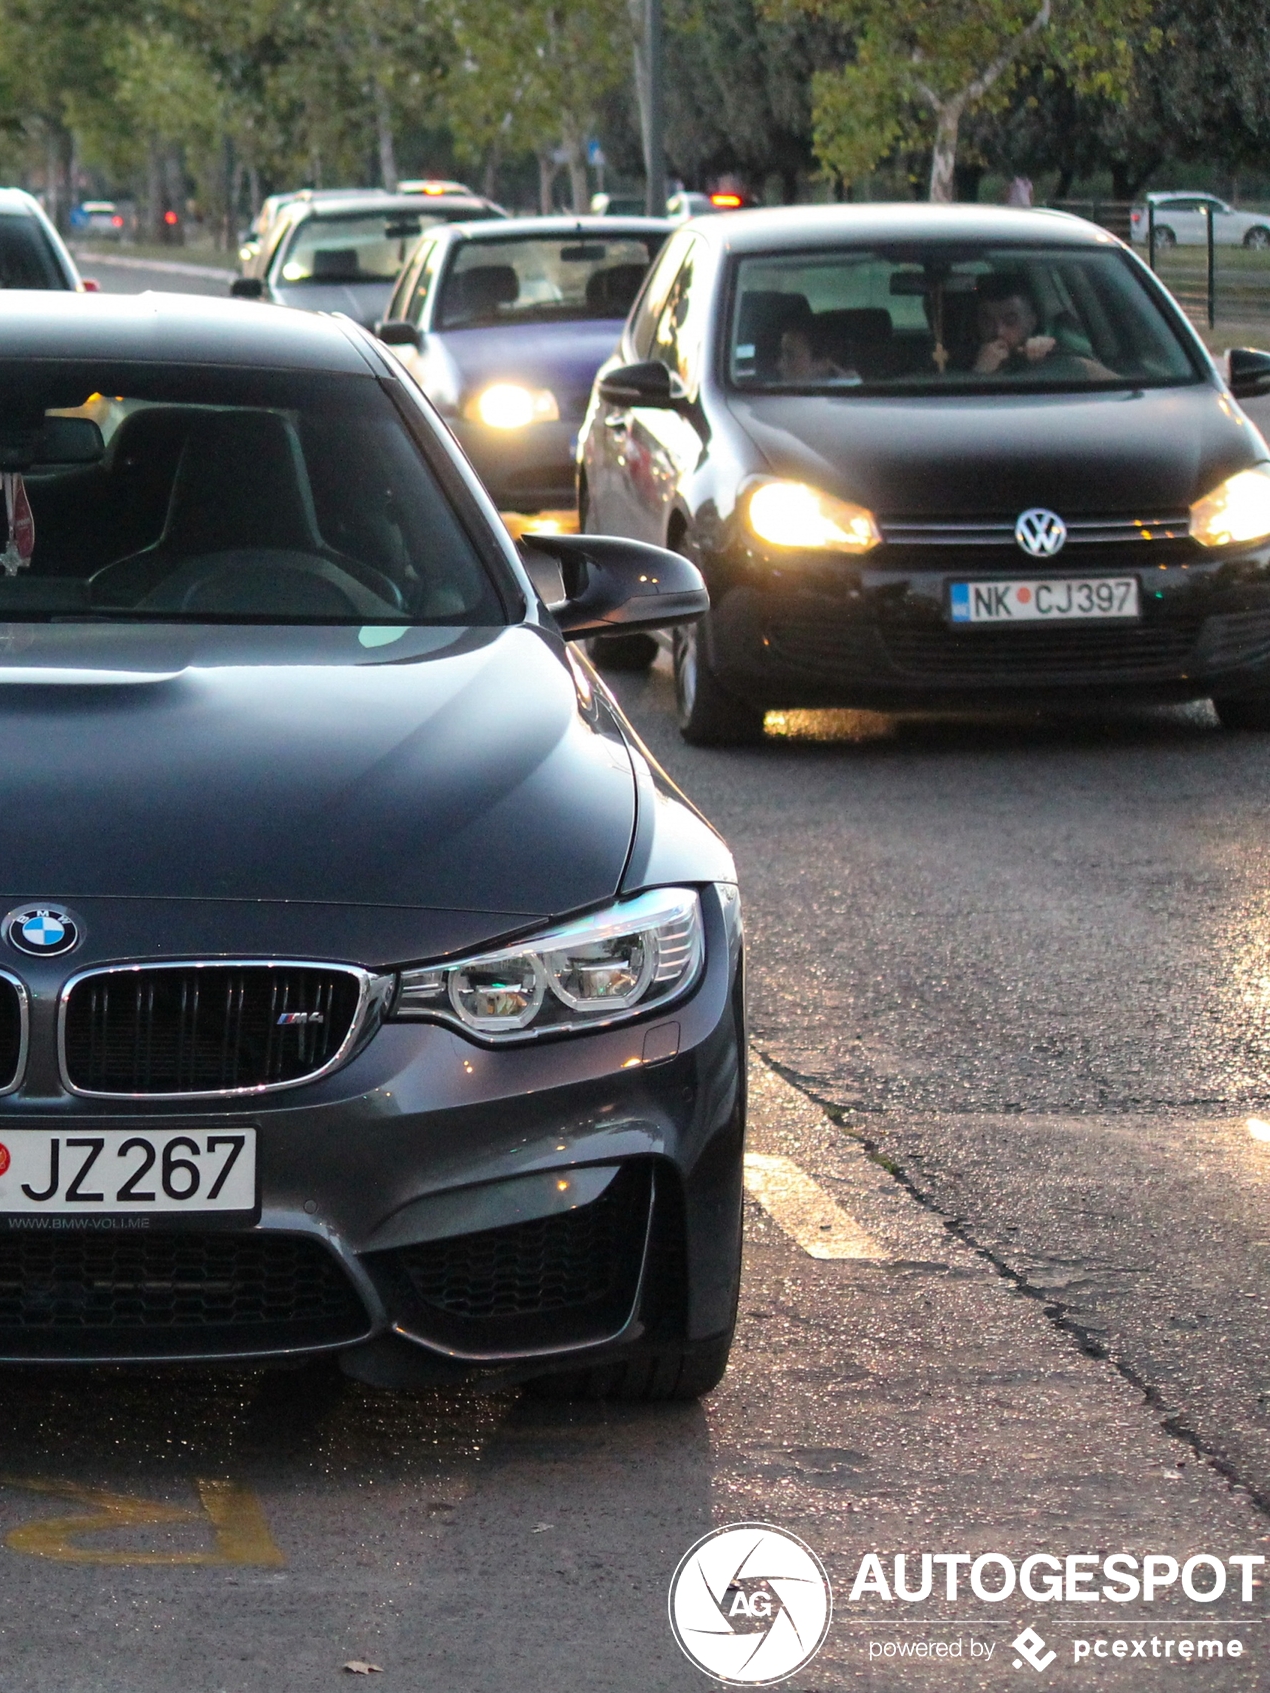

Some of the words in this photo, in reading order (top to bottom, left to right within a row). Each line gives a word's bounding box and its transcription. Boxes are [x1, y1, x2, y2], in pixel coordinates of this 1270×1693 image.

[1015, 508, 1067, 557] VW
[974, 586, 1011, 616] NK
[1034, 582, 1132, 615] CJ397
[16, 910, 72, 925] BMW
[289, 1011, 324, 1025] M4
[21, 1135, 246, 1202] JZ267
[8, 1217, 150, 1229] WWW.BMW-VOLI.ME
